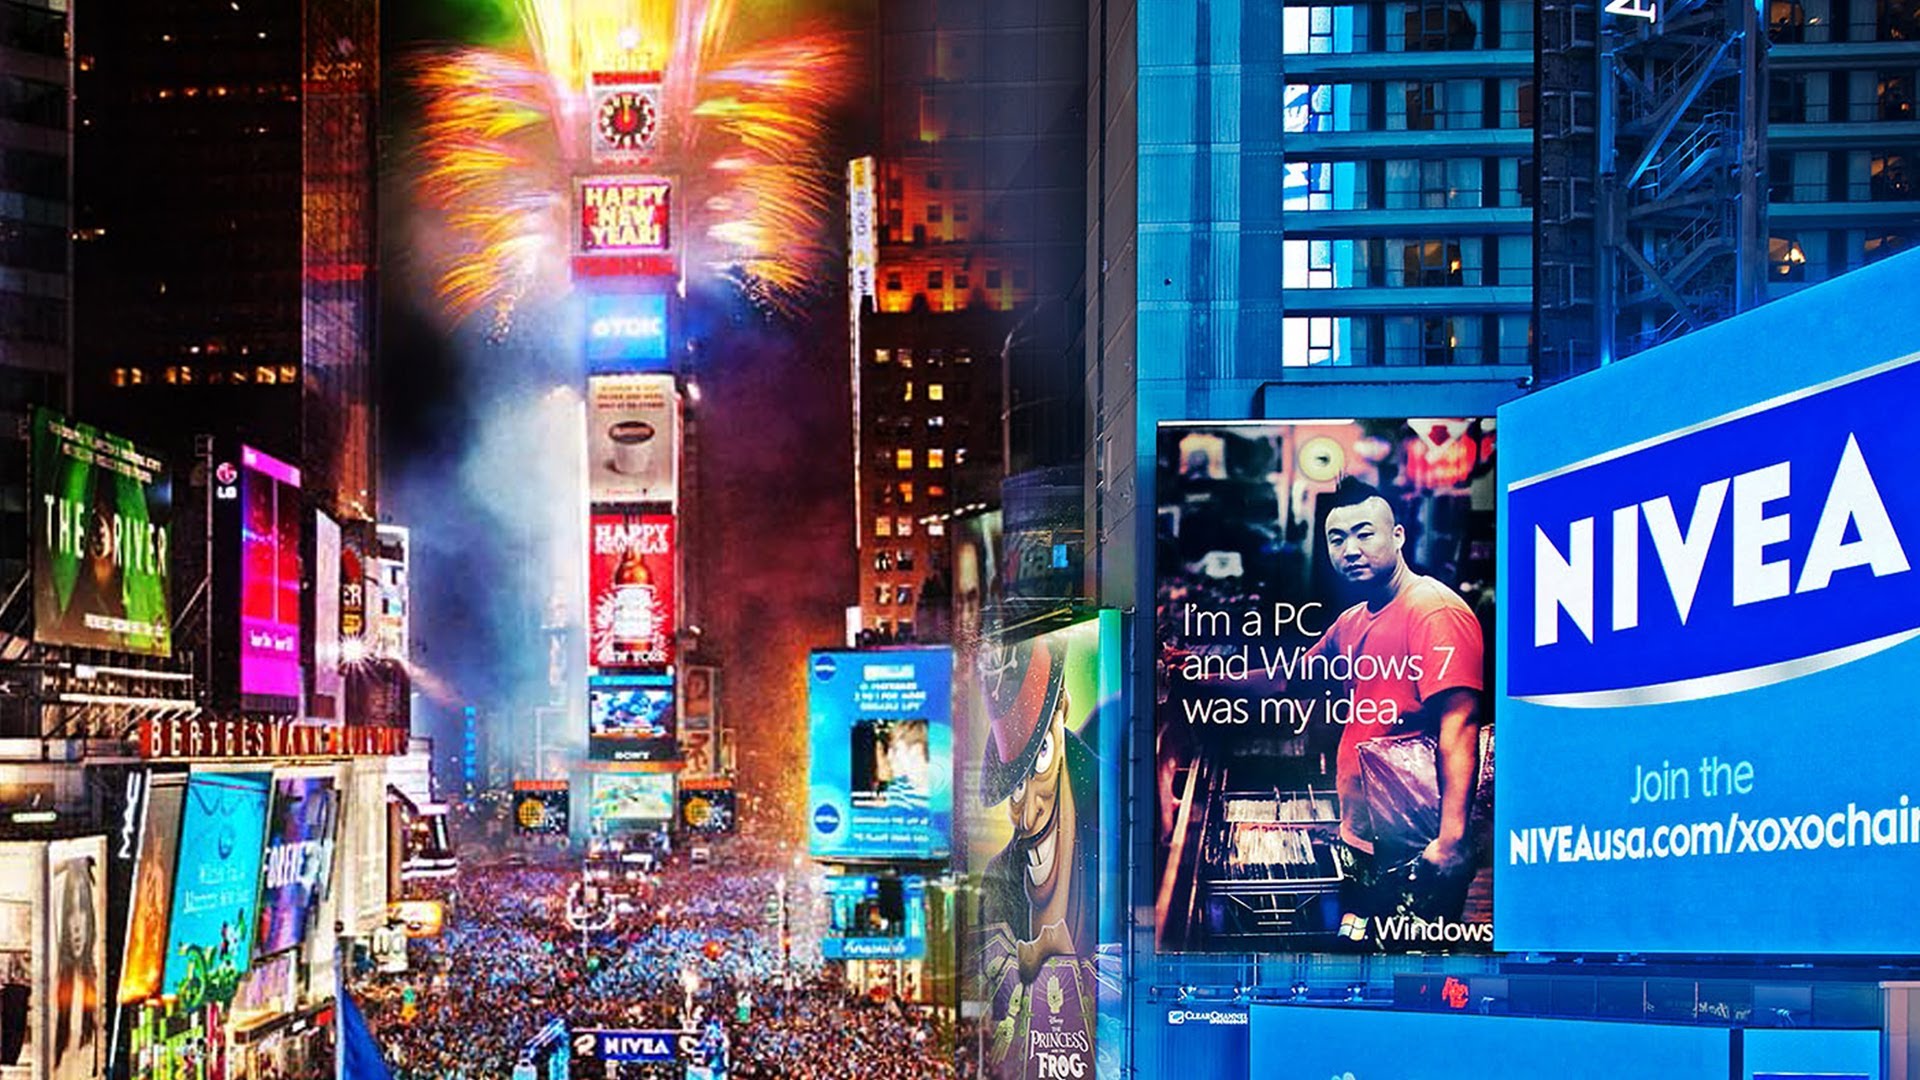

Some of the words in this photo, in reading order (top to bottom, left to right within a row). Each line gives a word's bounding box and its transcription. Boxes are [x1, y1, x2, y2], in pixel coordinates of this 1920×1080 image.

[585, 186, 669, 208] HAPPY
[598, 206, 656, 228] NEW
[43, 493, 85, 560] THE
[113, 512, 168, 578] RIVER
[595, 523, 669, 541] HAPPY
[1534, 431, 1912, 648] NIVEA
[1241, 610, 1262, 637] a
[1273, 602, 1323, 637] PC
[1181, 644, 1249, 682] and
[1259, 644, 1425, 682] Windows
[1432, 645, 1456, 682] 7
[1182, 698, 1249, 725] was
[1260, 698, 1317, 735] my
[1324, 689, 1405, 726] idea.
[1630, 760, 1690, 804] Join
[1699, 755, 1755, 797] the
[1373, 915, 1495, 942] Windows
[604, 1037, 670, 1055] NIVEA
[1028, 1030, 1090, 1060] PRINCESS
[1035, 1053, 1089, 1080] FROG
